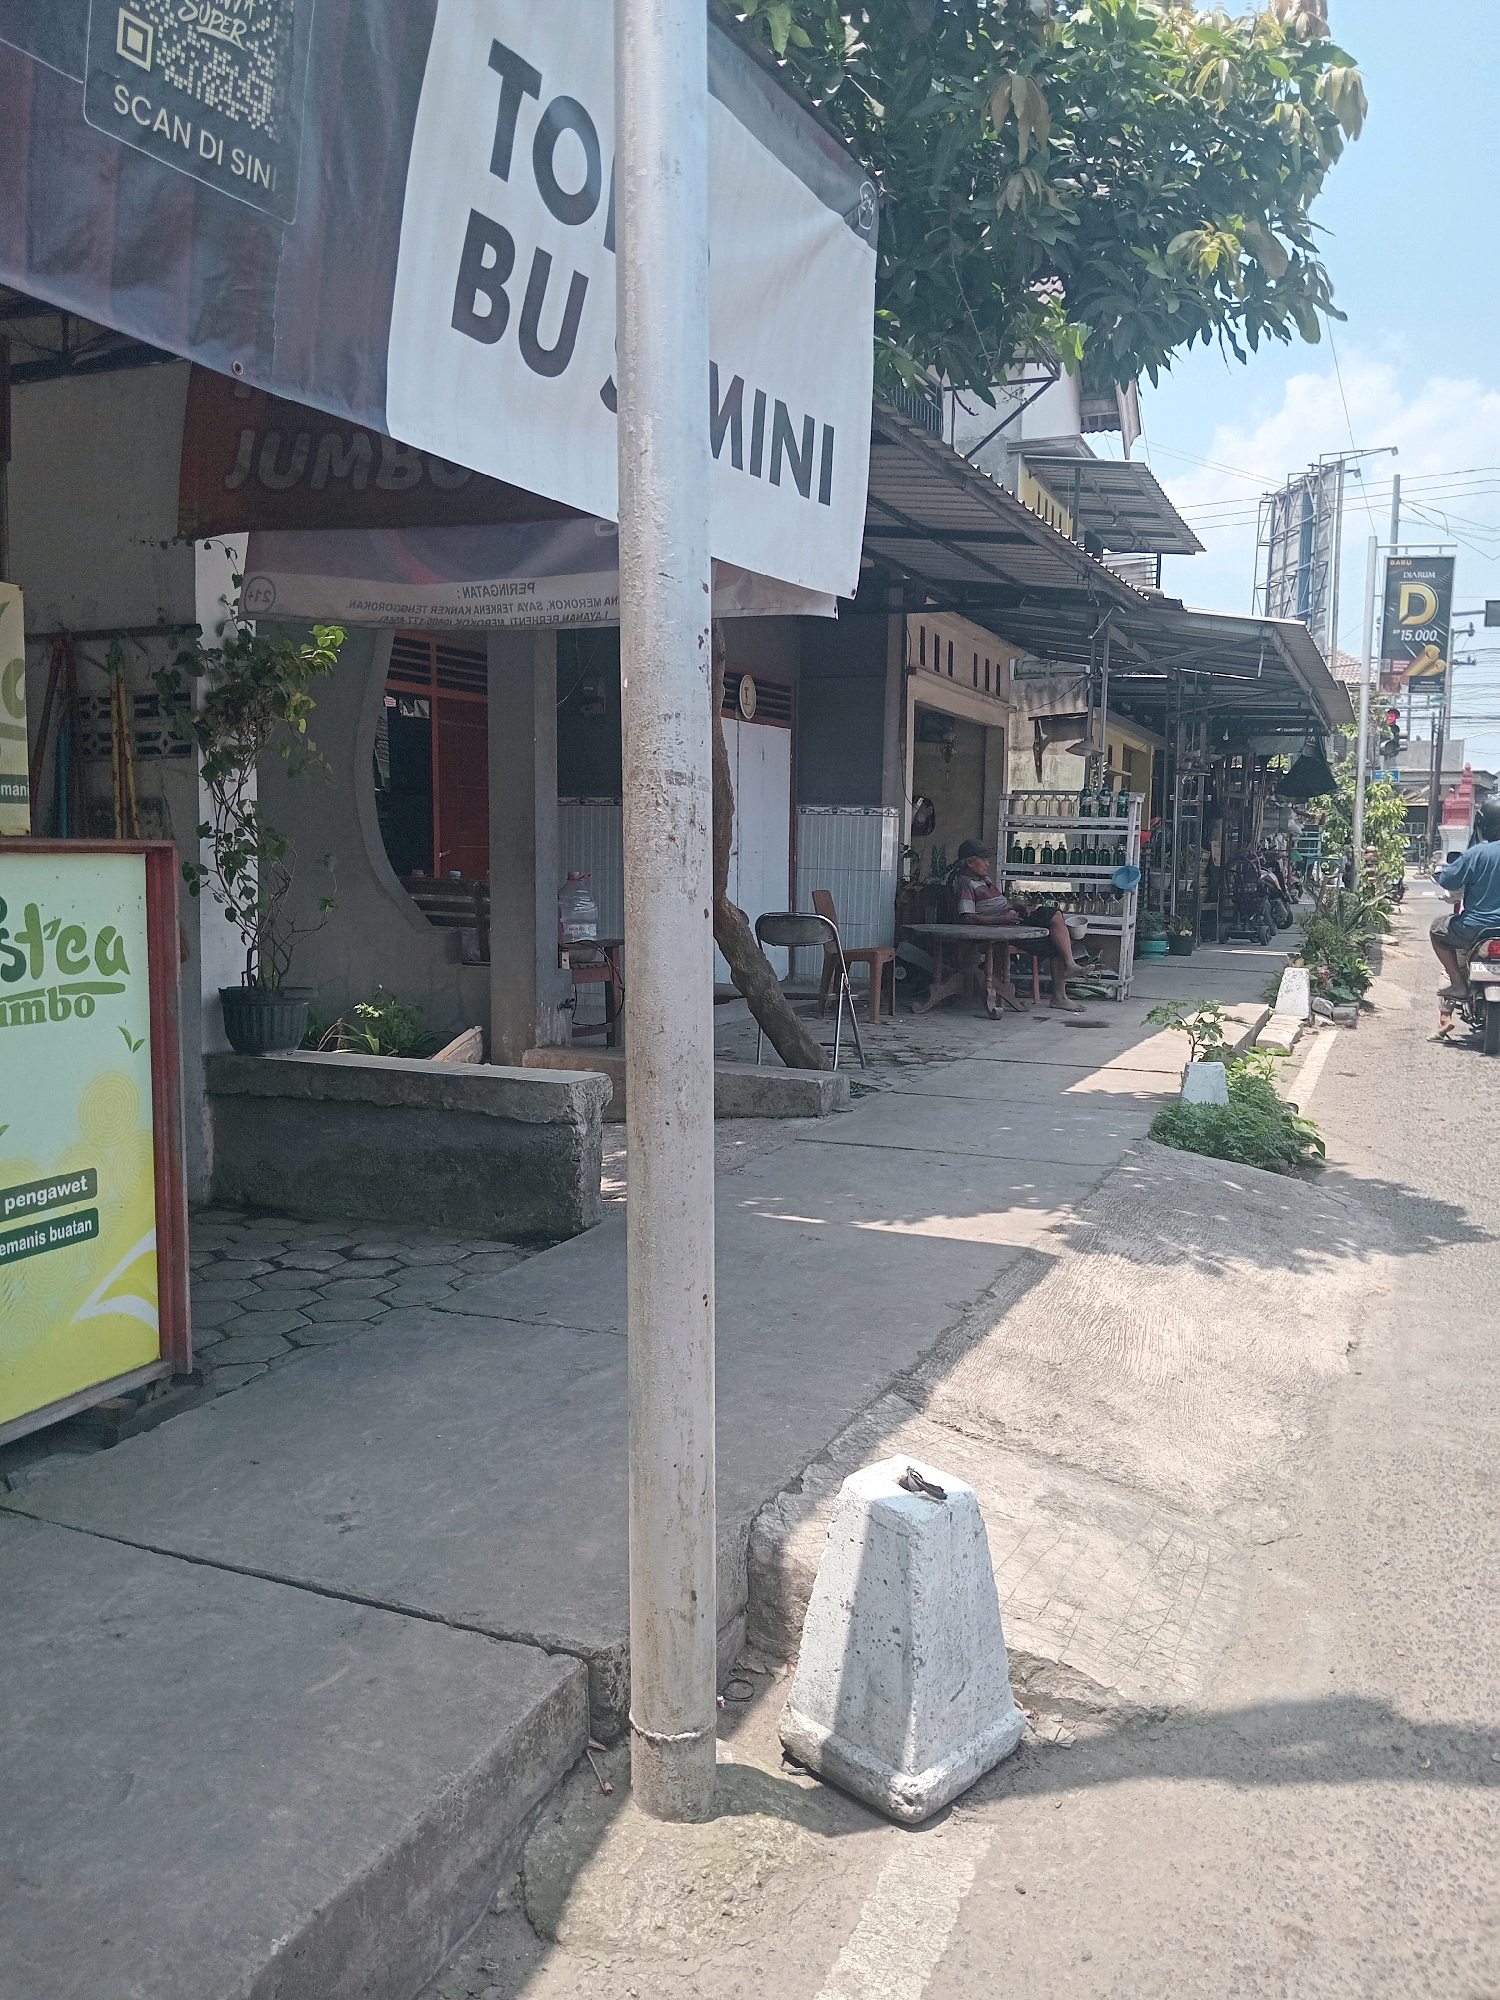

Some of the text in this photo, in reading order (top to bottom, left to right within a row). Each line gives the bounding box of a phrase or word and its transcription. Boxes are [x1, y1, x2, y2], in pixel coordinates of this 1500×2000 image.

[113, 85, 277, 192] SCAN DI SINI
[451, 207, 589, 378] BU
[1403, 571, 1436, 579] DJARUM
[1399, 581, 1439, 627] D
[1401, 629, 1438, 642] 15.000
[4, 1175, 88, 1215] pengawet
[50, 1219, 93, 1243] buatan
